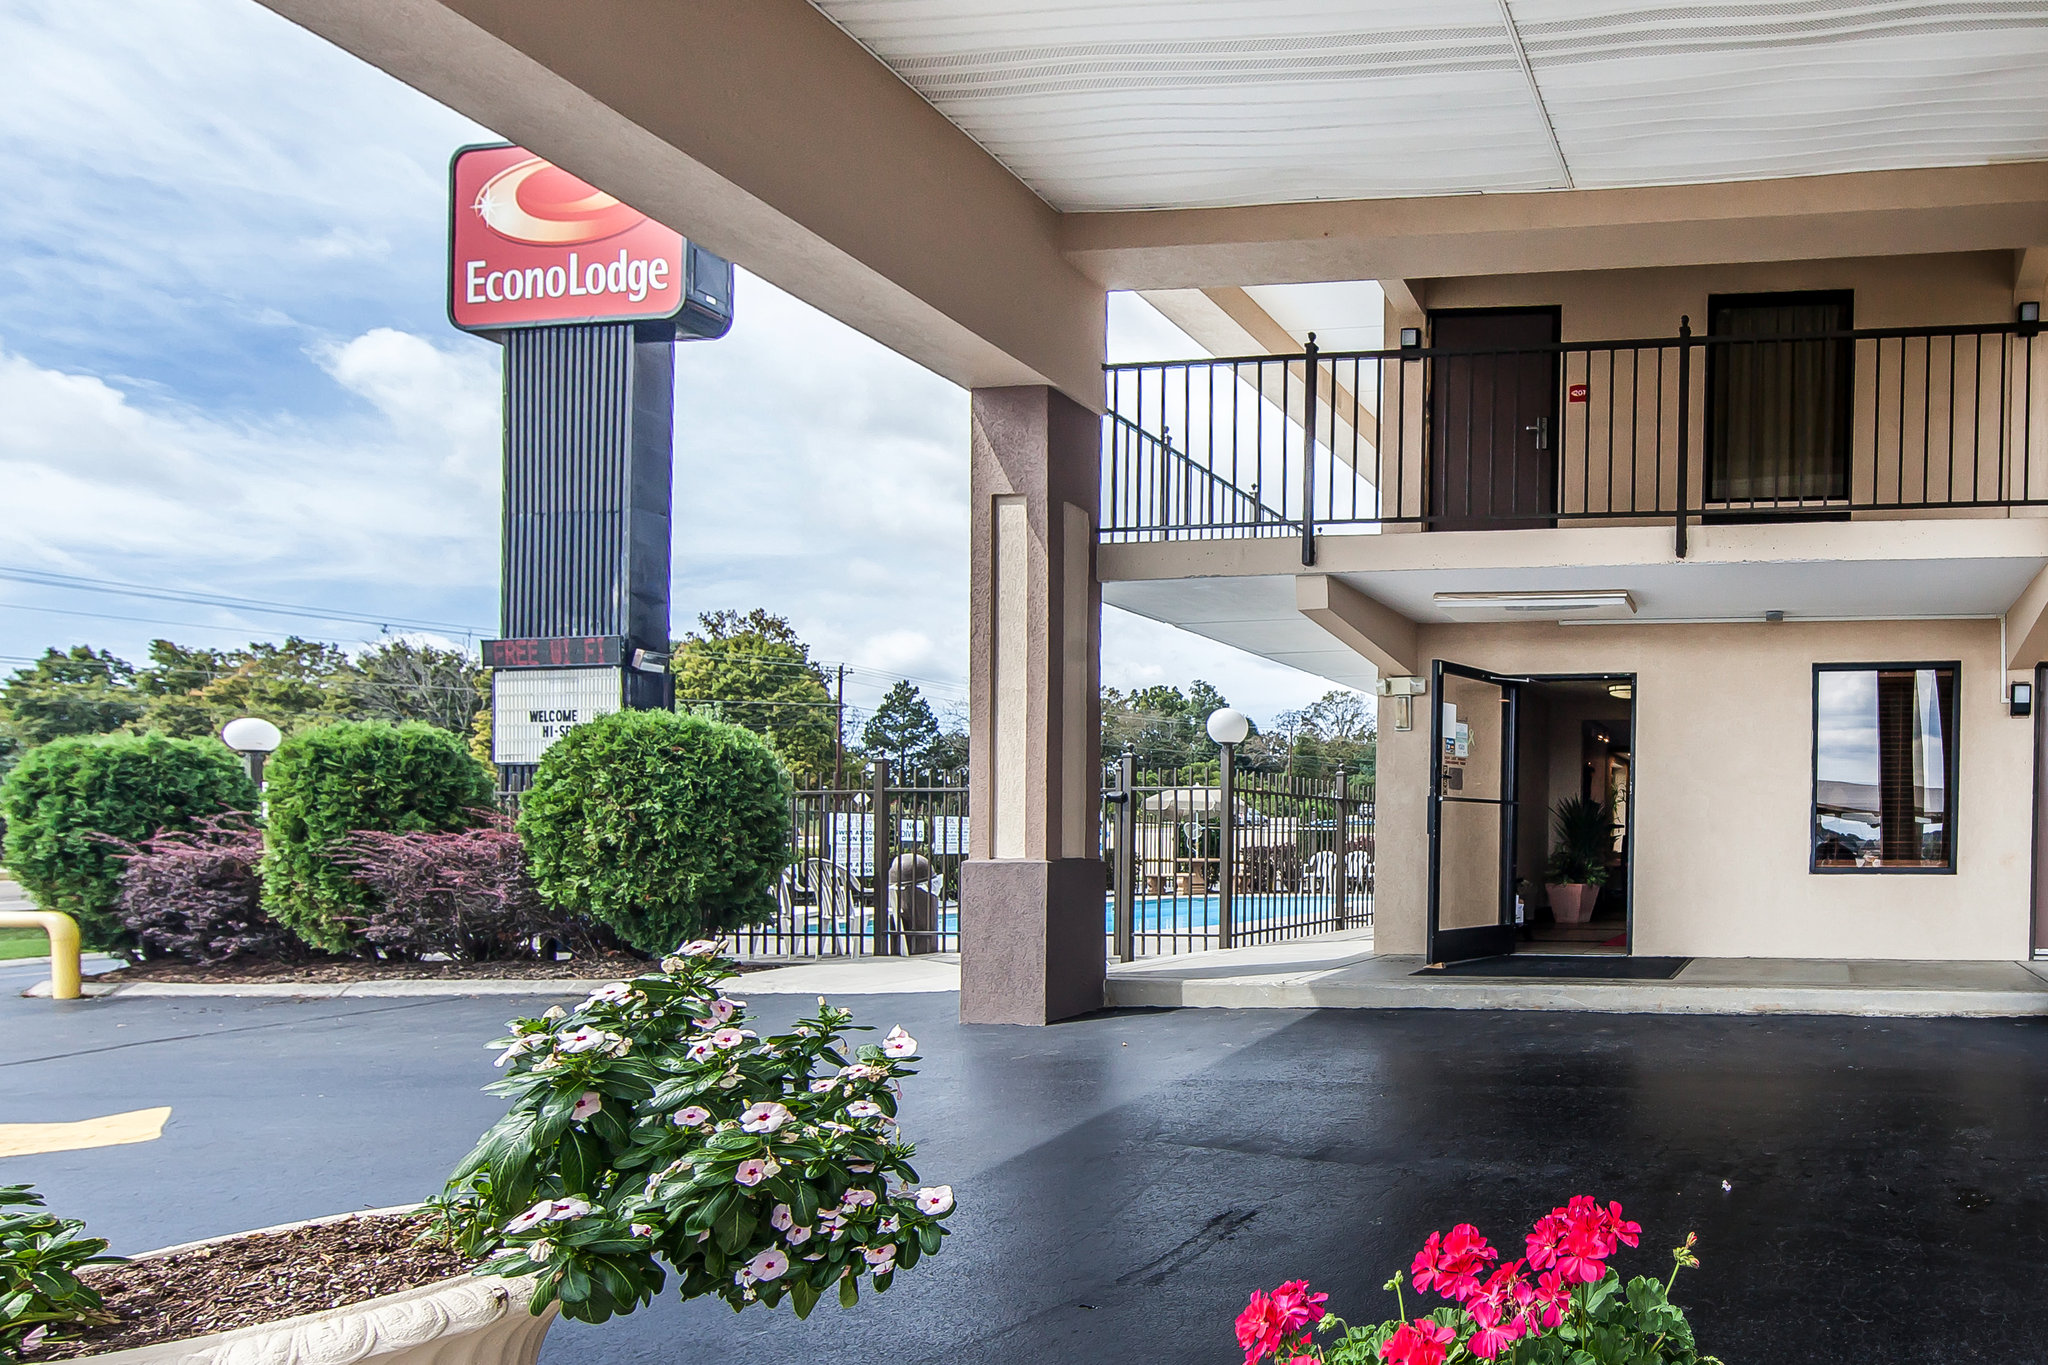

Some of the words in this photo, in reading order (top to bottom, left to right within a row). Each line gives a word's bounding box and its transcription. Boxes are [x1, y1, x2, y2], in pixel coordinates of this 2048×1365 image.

[466, 249, 669, 304] EconoLodge
[493, 639, 539, 666] FREE
[583, 637, 605, 664] FI
[529, 709, 578, 723] WELCOME
